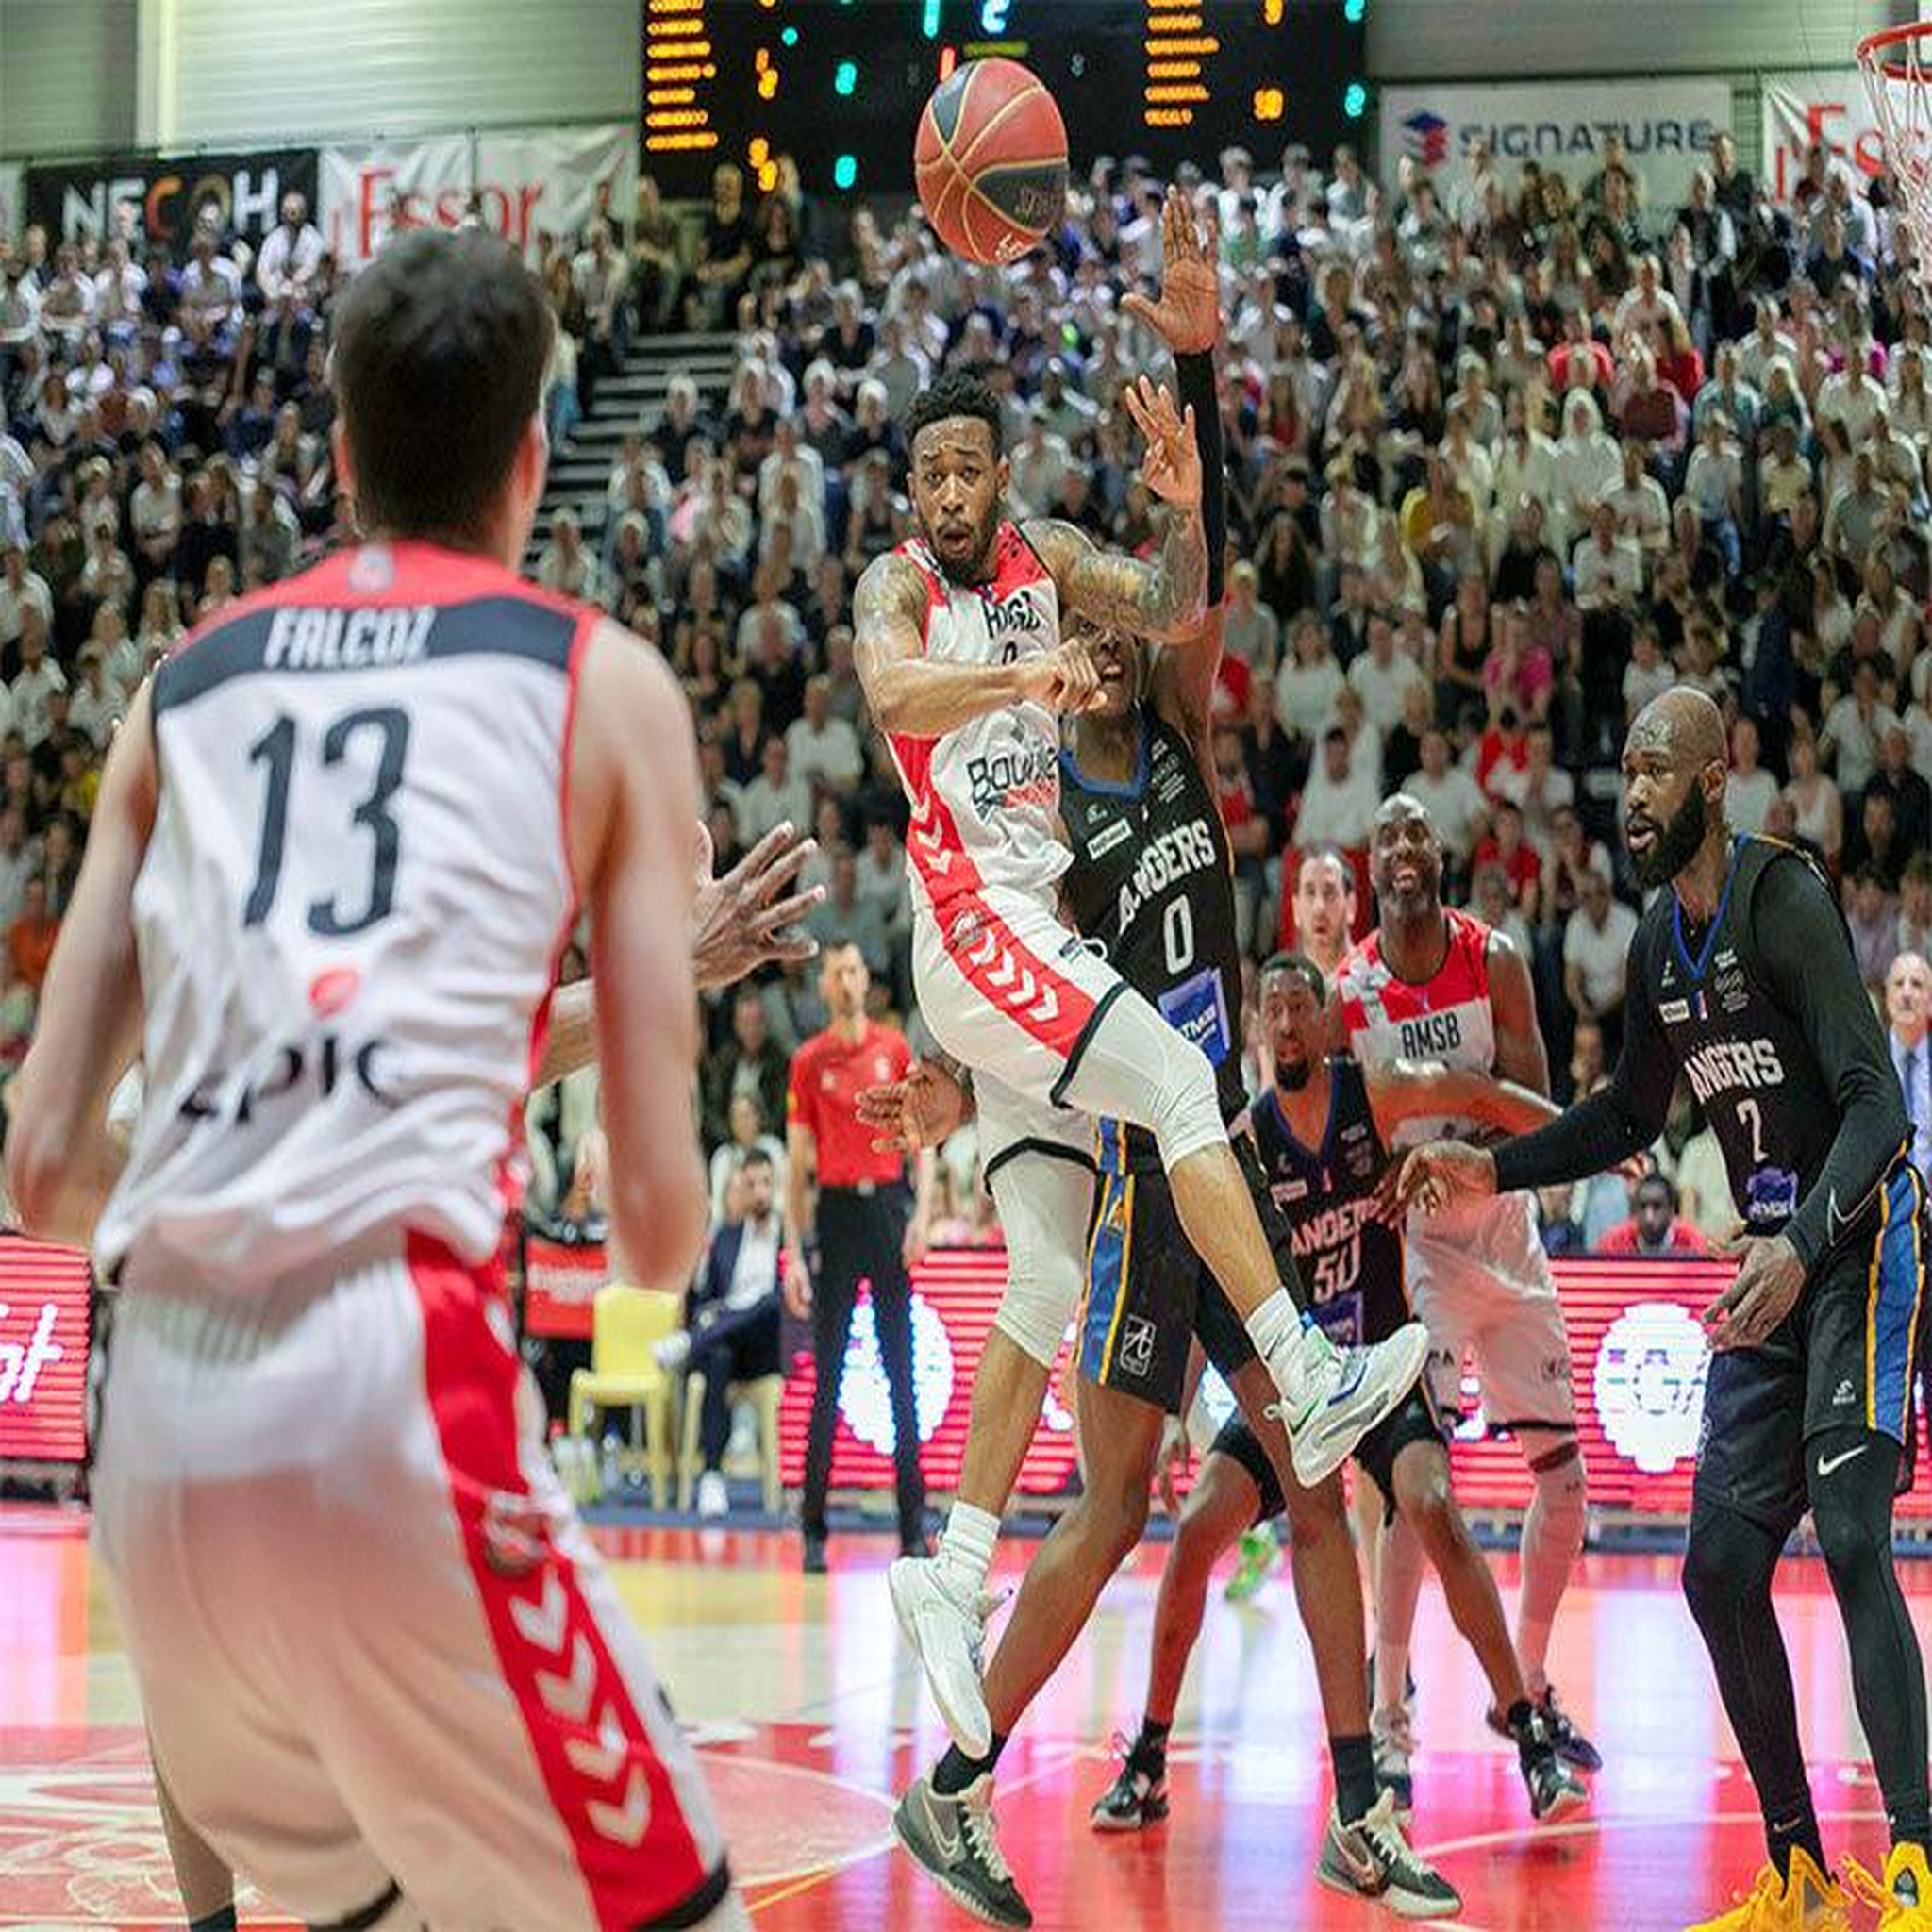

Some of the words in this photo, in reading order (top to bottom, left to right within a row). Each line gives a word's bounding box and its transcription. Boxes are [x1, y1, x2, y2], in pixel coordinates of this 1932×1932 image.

[1459, 119, 1715, 158] SIGNATURE
[243, 706, 411, 937] 13
[1164, 894, 1194, 975] 0
[1402, 1012, 1461, 1059] AMSB
[1684, 1038, 1785, 1106] ANGERS
